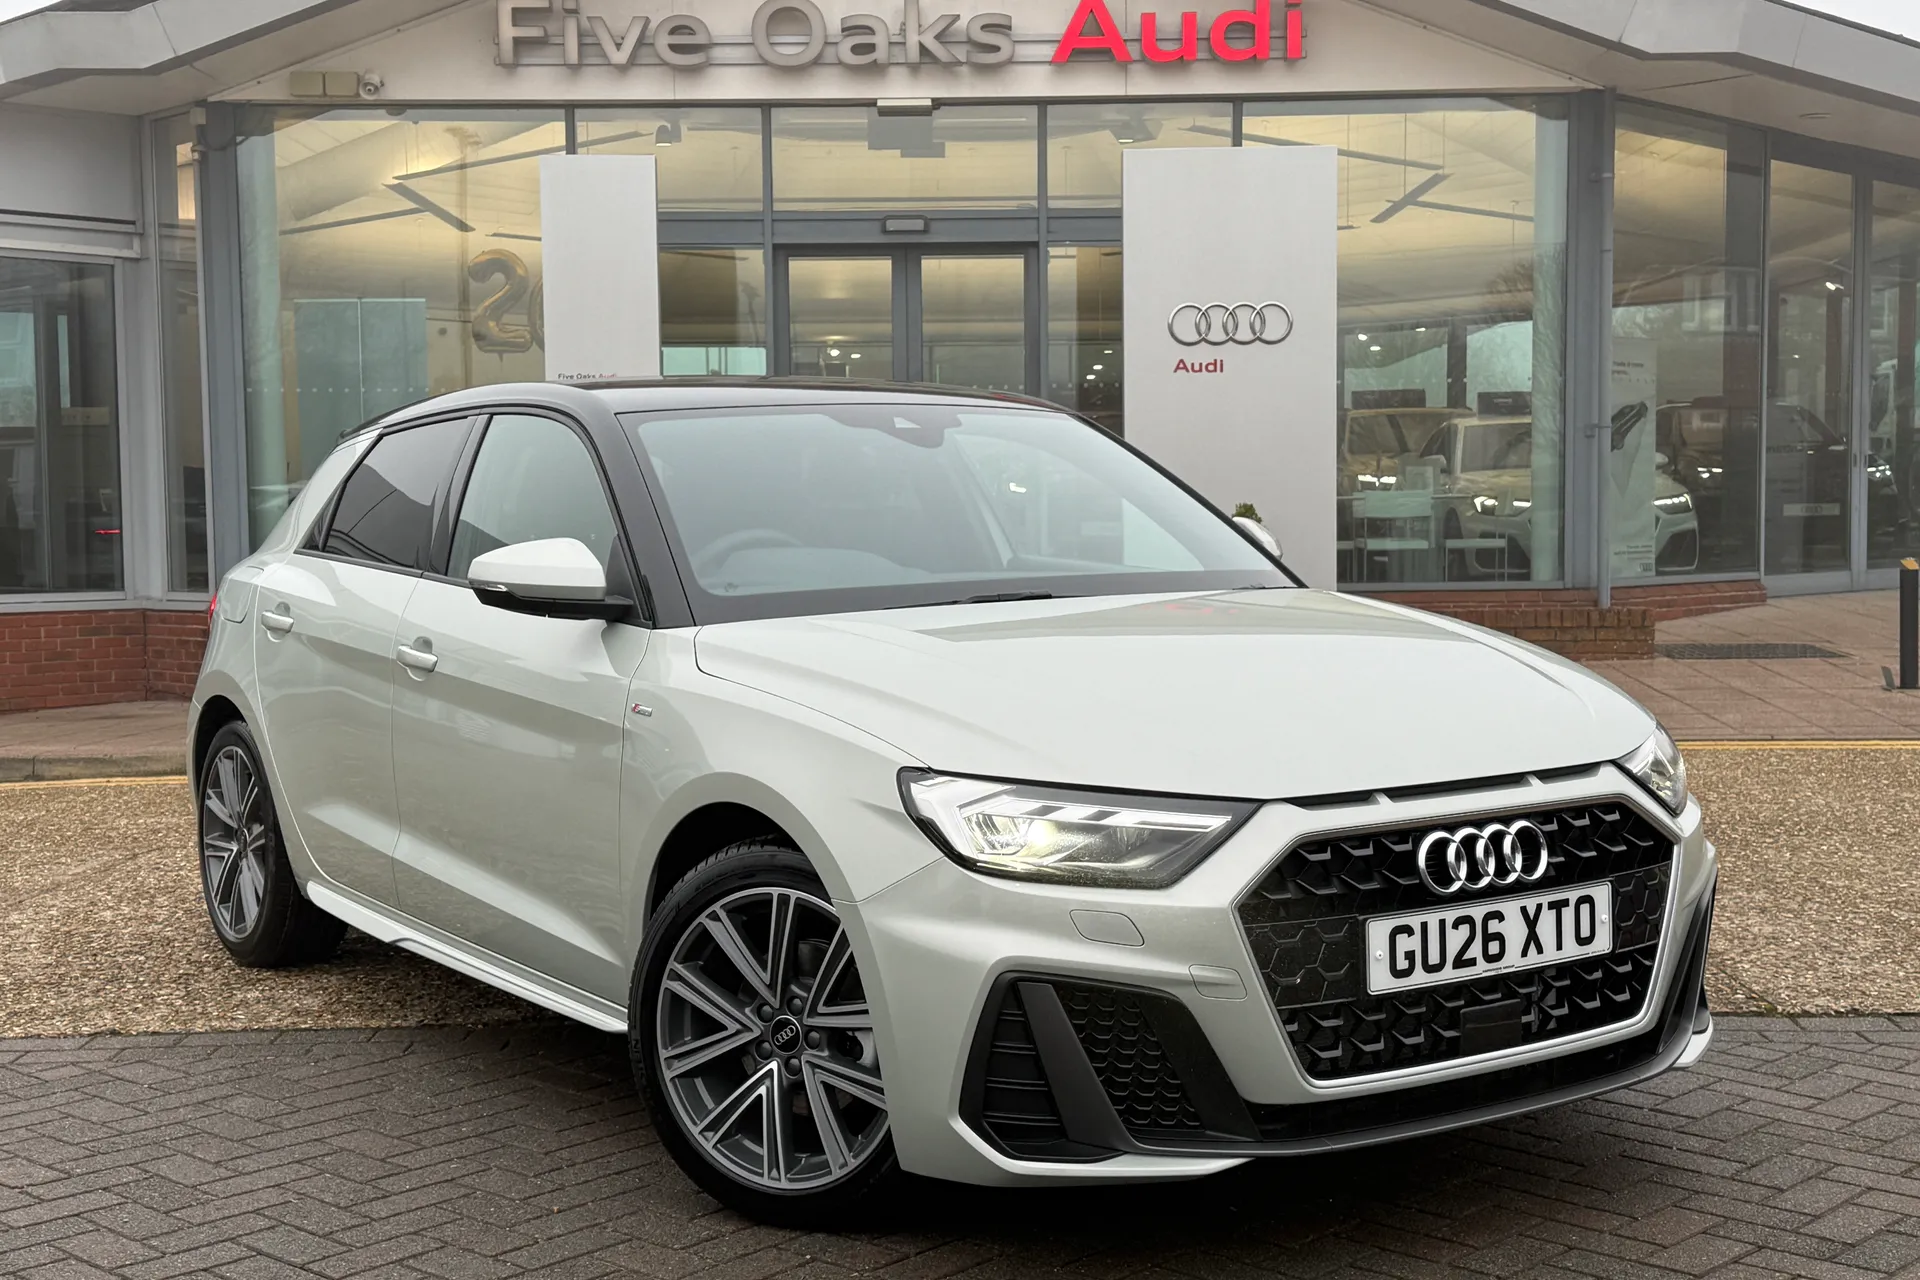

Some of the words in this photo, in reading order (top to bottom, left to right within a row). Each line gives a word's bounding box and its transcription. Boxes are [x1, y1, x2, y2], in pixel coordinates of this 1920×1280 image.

[497, 0, 712, 69] Five
[751, 0, 1014, 68] Oaks
[1051, 0, 1303, 64] Audi
[1173, 358, 1224, 373] Audi
[1388, 910, 1506, 980] GU26
[1519, 894, 1597, 958] XTO
